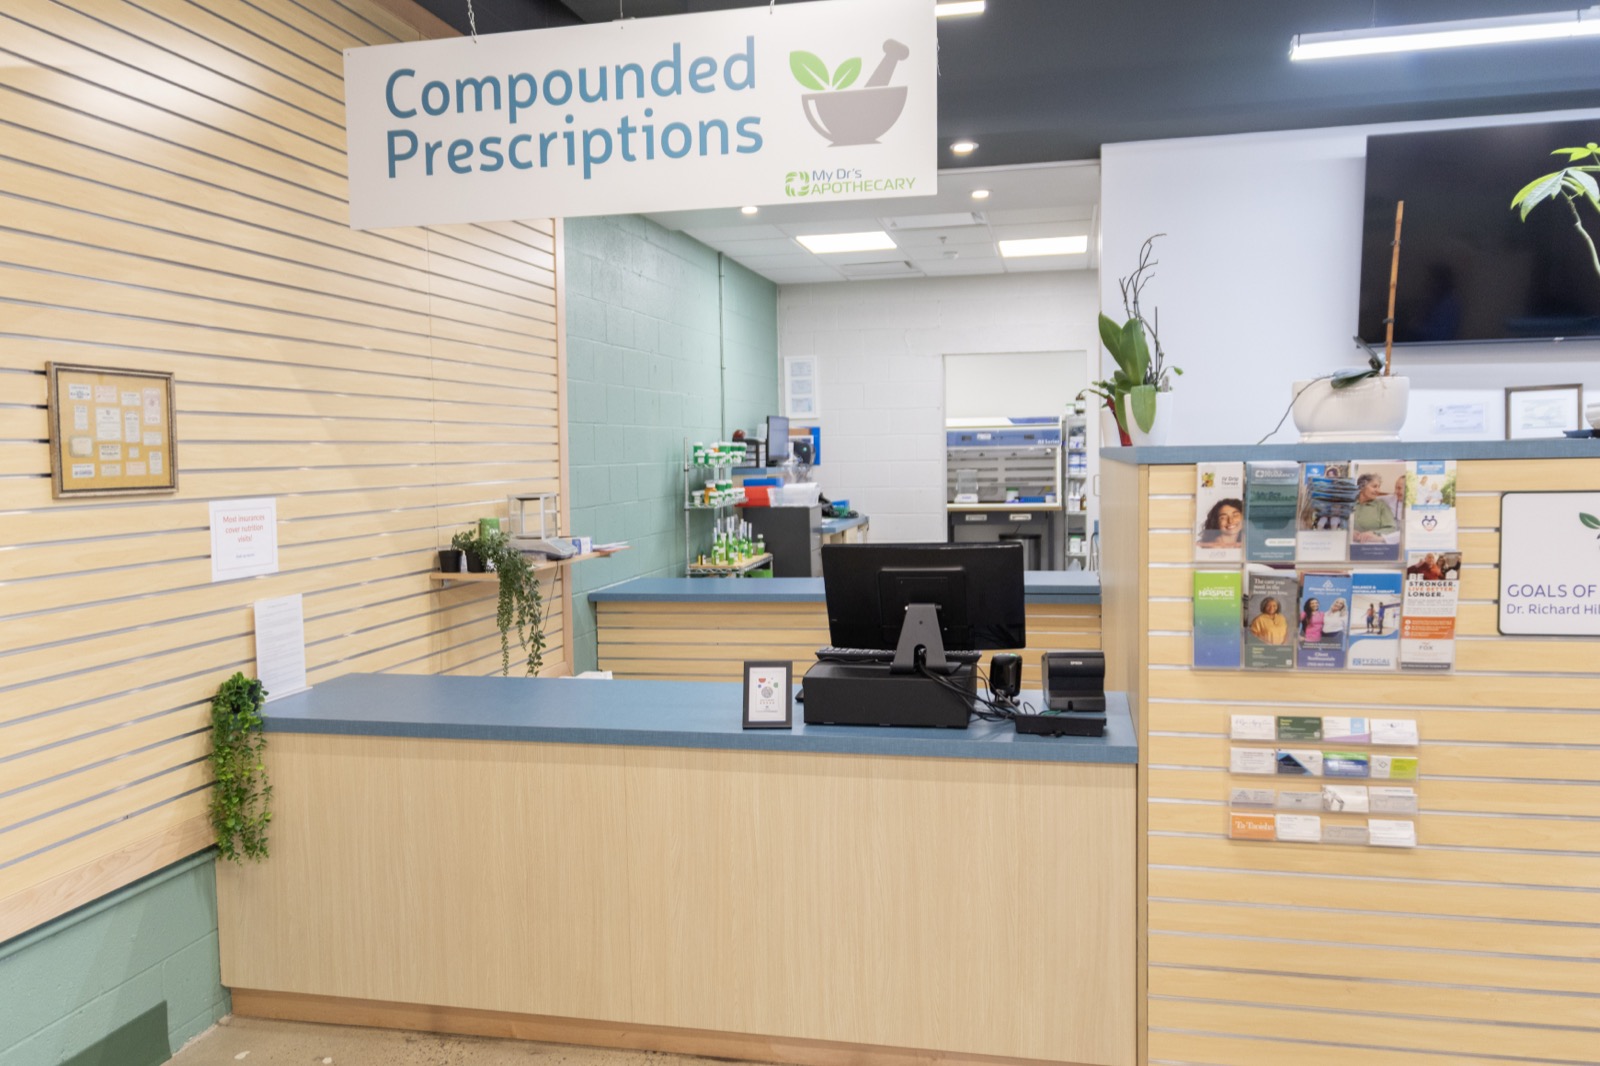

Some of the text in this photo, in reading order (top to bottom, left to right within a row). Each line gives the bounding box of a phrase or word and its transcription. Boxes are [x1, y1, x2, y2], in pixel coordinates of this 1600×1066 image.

[385, 35, 755, 124] Compounded
[387, 108, 763, 179] Prescriptions
[812, 168, 862, 182] My Dr's
[811, 177, 916, 194] APOTHECARY
[239, 514, 265, 522] insurances
[242, 524, 263, 532] nutrition
[238, 534, 252, 542] visits!
[1507, 584, 1597, 598] GOALS OF
[1506, 603, 1524, 615] Dr.
[1528, 603, 1580, 615] Richard
